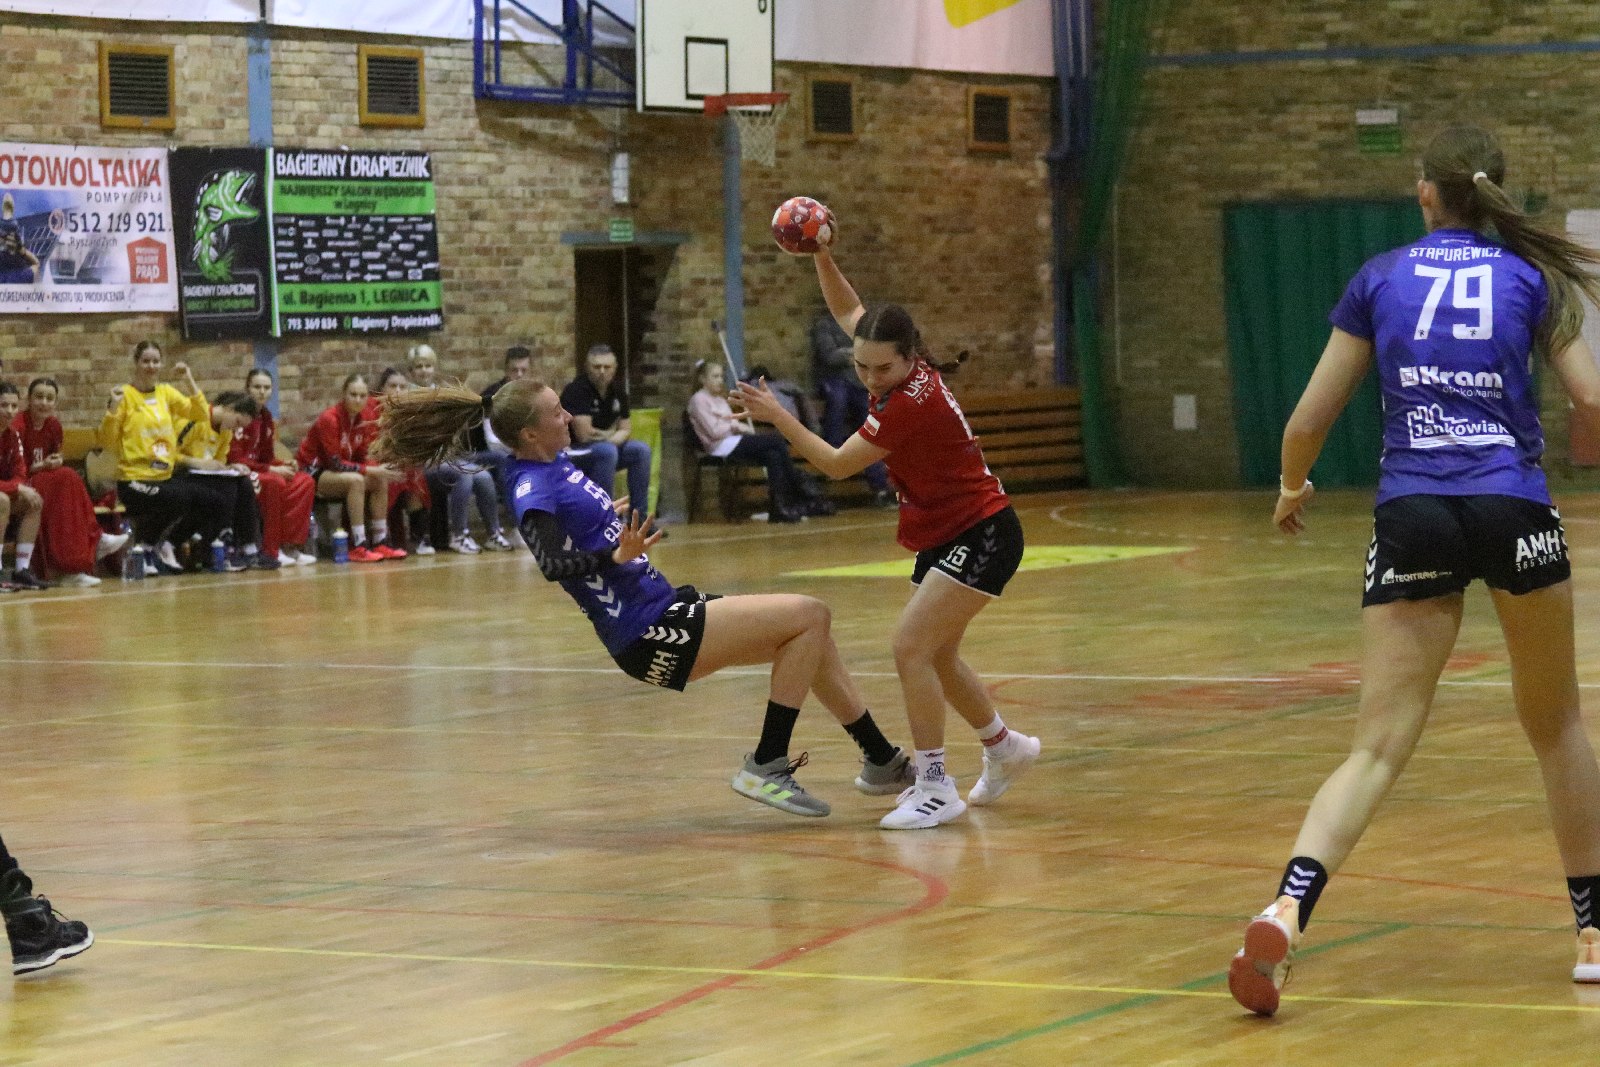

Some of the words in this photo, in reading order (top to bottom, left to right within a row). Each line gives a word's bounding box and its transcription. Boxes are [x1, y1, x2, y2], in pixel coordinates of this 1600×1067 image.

[276, 152, 347, 177] BAGIENNY
[350, 153, 430, 178] DRAPIEŻNIK
[86, 191, 127, 203] POMPY
[69, 212, 101, 233] 512
[107, 212, 131, 233] 119
[136, 212, 165, 233] 921
[1408, 246, 1503, 262] STAPUREWICZ
[374, 288, 430, 304] LEGNICA
[1414, 263, 1493, 340] 79
[1419, 365, 1503, 389] Kram
[1415, 420, 1509, 437] Jankowiak
[1515, 529, 1561, 563] AMH
[644, 650, 673, 687] AMH
